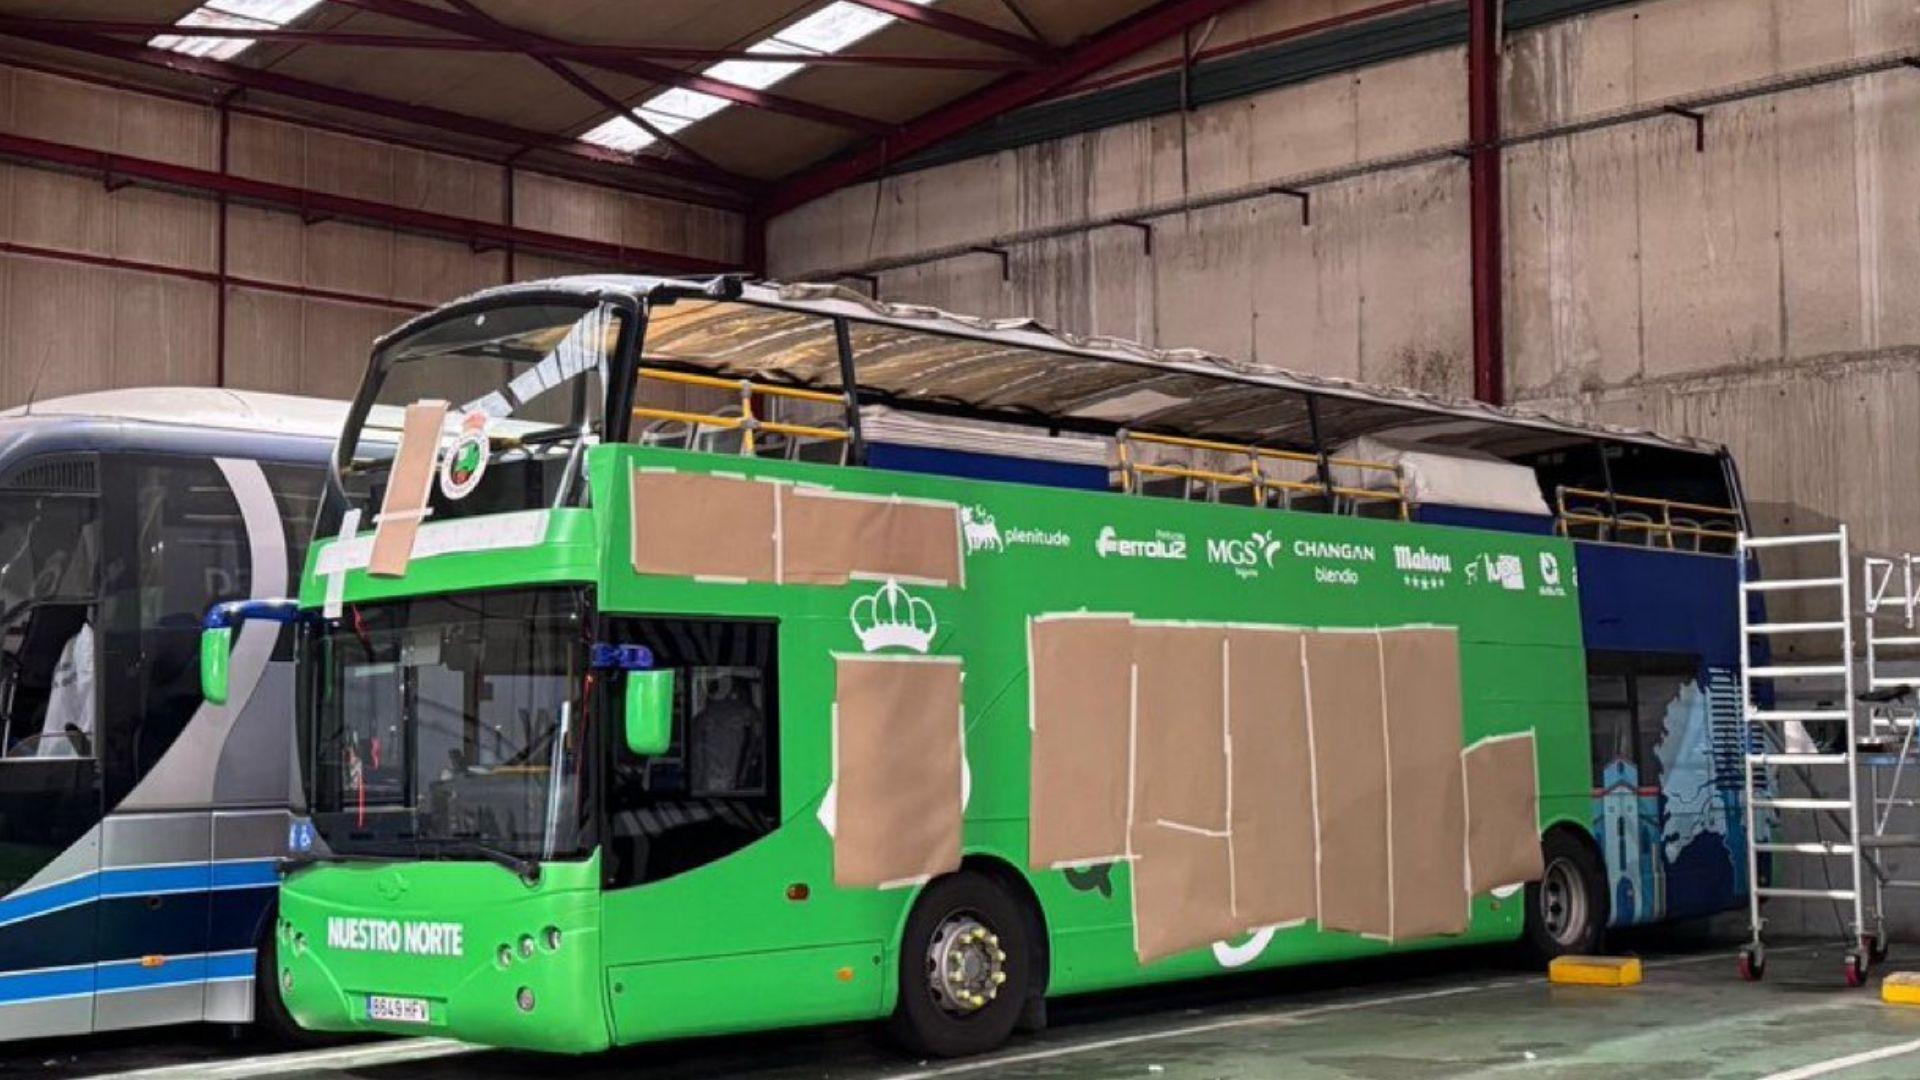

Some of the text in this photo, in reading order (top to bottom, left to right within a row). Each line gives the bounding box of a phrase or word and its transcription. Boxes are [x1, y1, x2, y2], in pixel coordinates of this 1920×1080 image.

[1004, 527, 1070, 547] plenitude
[1294, 540, 1376, 561] CHANGAN
[1207, 538, 1258, 565] MGS
[1394, 545, 1452, 573] Mahou
[328, 916, 464, 957] NUESTRO NORTE
